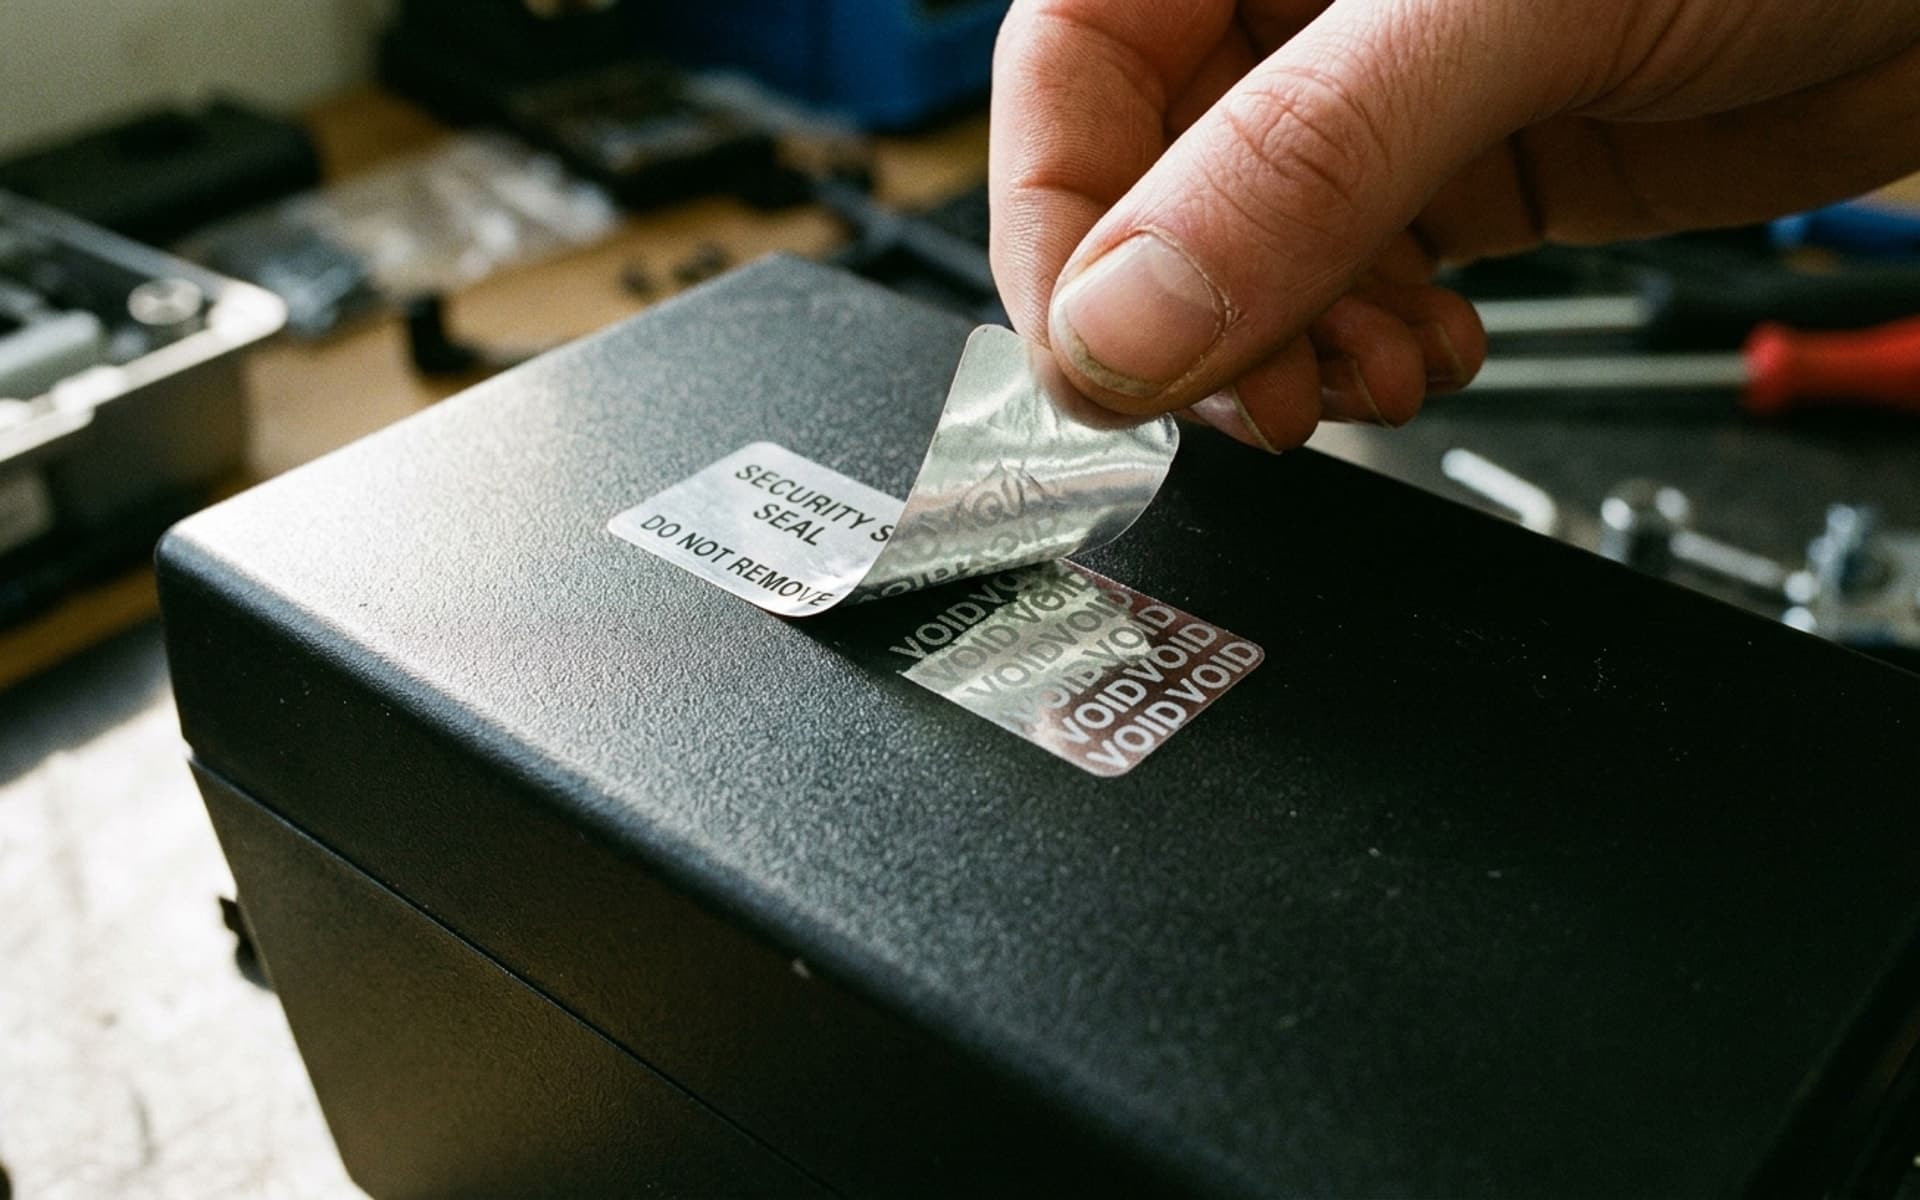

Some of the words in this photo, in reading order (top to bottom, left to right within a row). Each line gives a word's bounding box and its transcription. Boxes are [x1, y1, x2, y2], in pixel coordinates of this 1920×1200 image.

[736, 464, 875, 530] SECURITY
[754, 503, 827, 546] SEAL
[641, 515, 681, 538] DO
[676, 532, 735, 563] NOT
[727, 557, 834, 606] REMOVE
[1085, 700, 1187, 768] VOID
[1164, 641, 1259, 704] VOID
